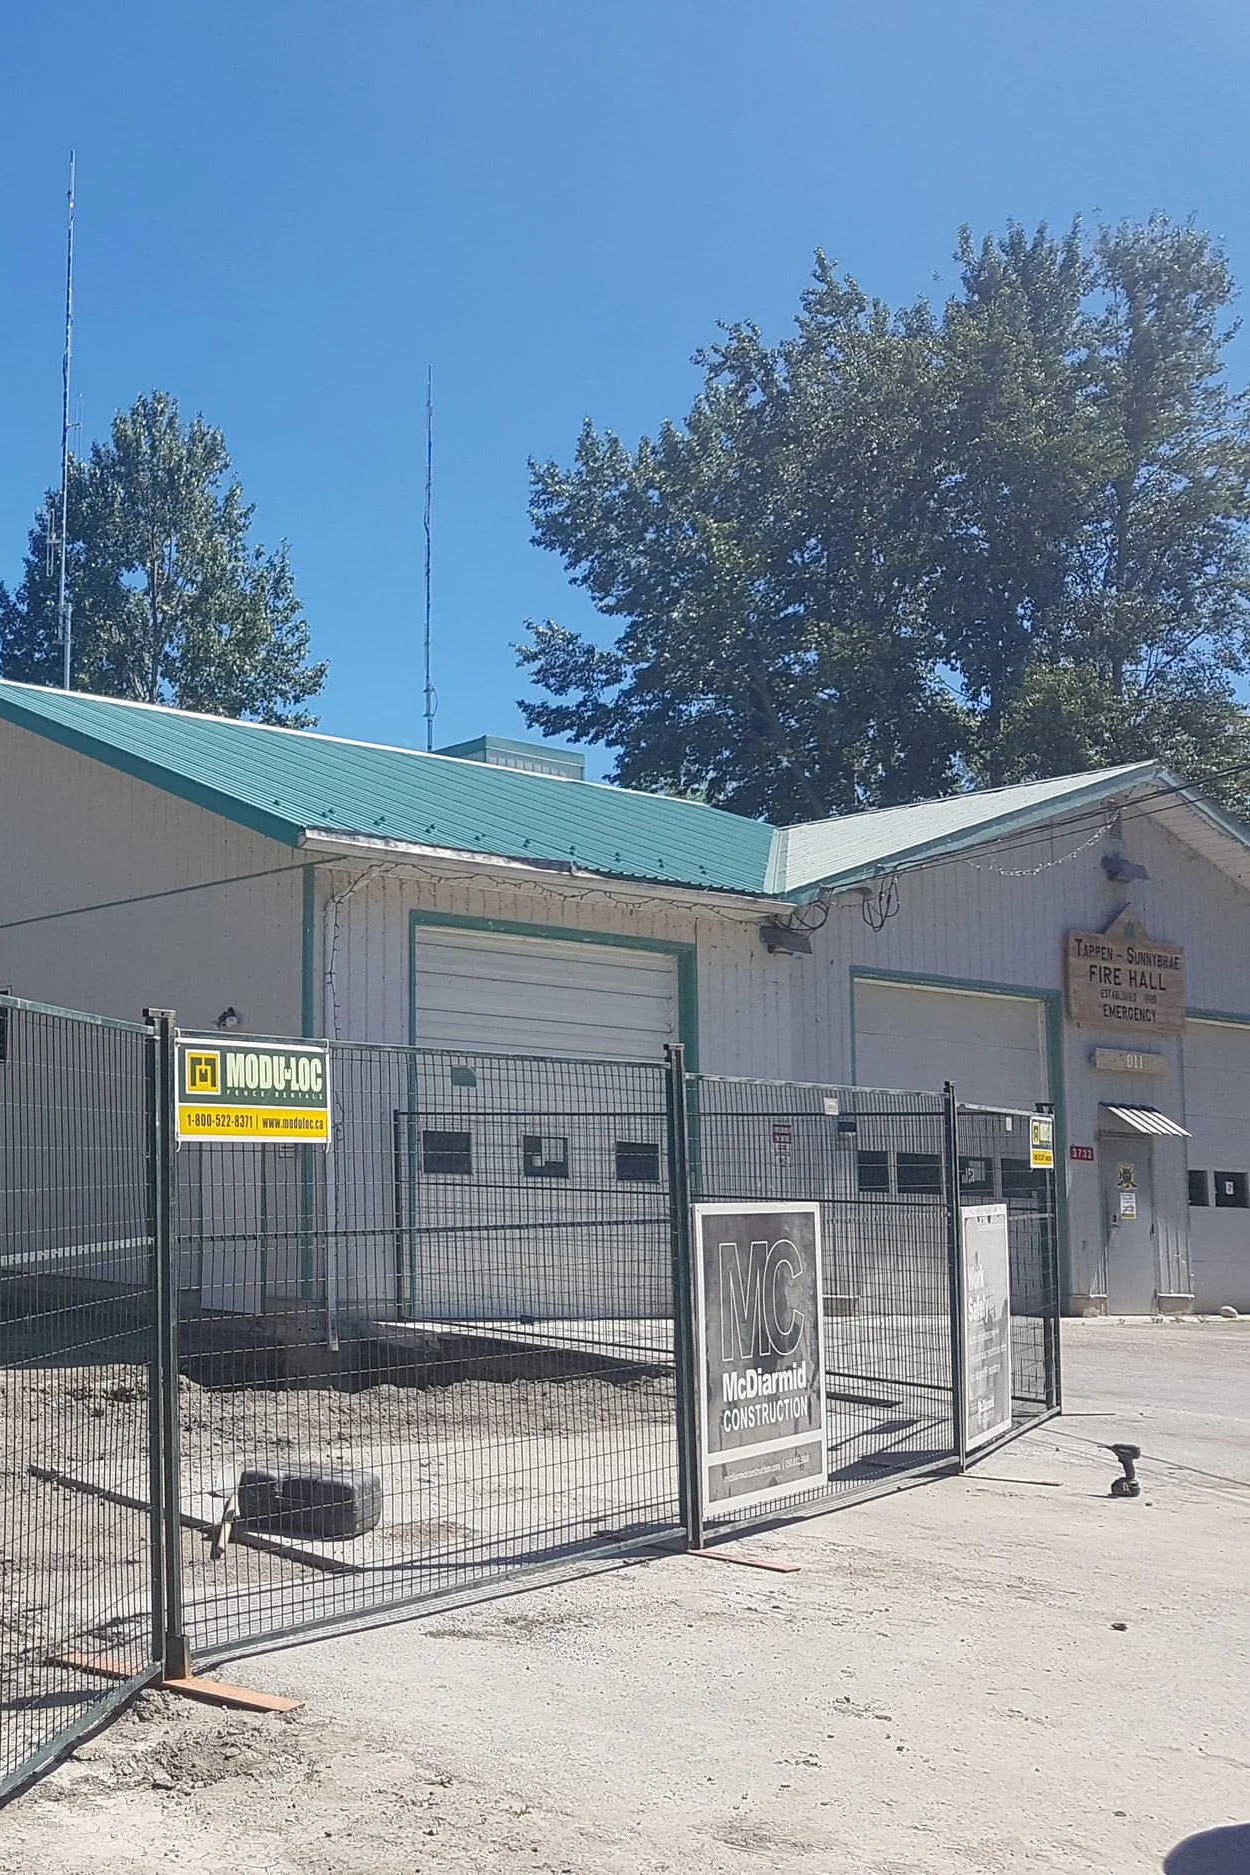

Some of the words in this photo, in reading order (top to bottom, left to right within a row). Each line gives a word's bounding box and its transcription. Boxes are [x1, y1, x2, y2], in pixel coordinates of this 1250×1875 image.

[1074, 938, 1114, 961] TAPPEN
[1126, 946, 1180, 970] SUNNYBRAE
[1089, 965, 1122, 986] FIRE
[1129, 970, 1167, 991] HALL
[1103, 1003, 1157, 1022] EMERGENCY
[226, 1088, 265, 1098] FENCE
[274, 1091, 323, 1100] RENTALS
[186, 1112, 254, 1129] 1-800-522-8371
[262, 1115, 324, 1130] www.moduloc.ca
[1072, 1148, 1093, 1160] 3732
[718, 1239, 805, 1362] MC
[722, 1360, 807, 1403] McDiarmid
[723, 1394, 809, 1433] CONSTRUCTION
